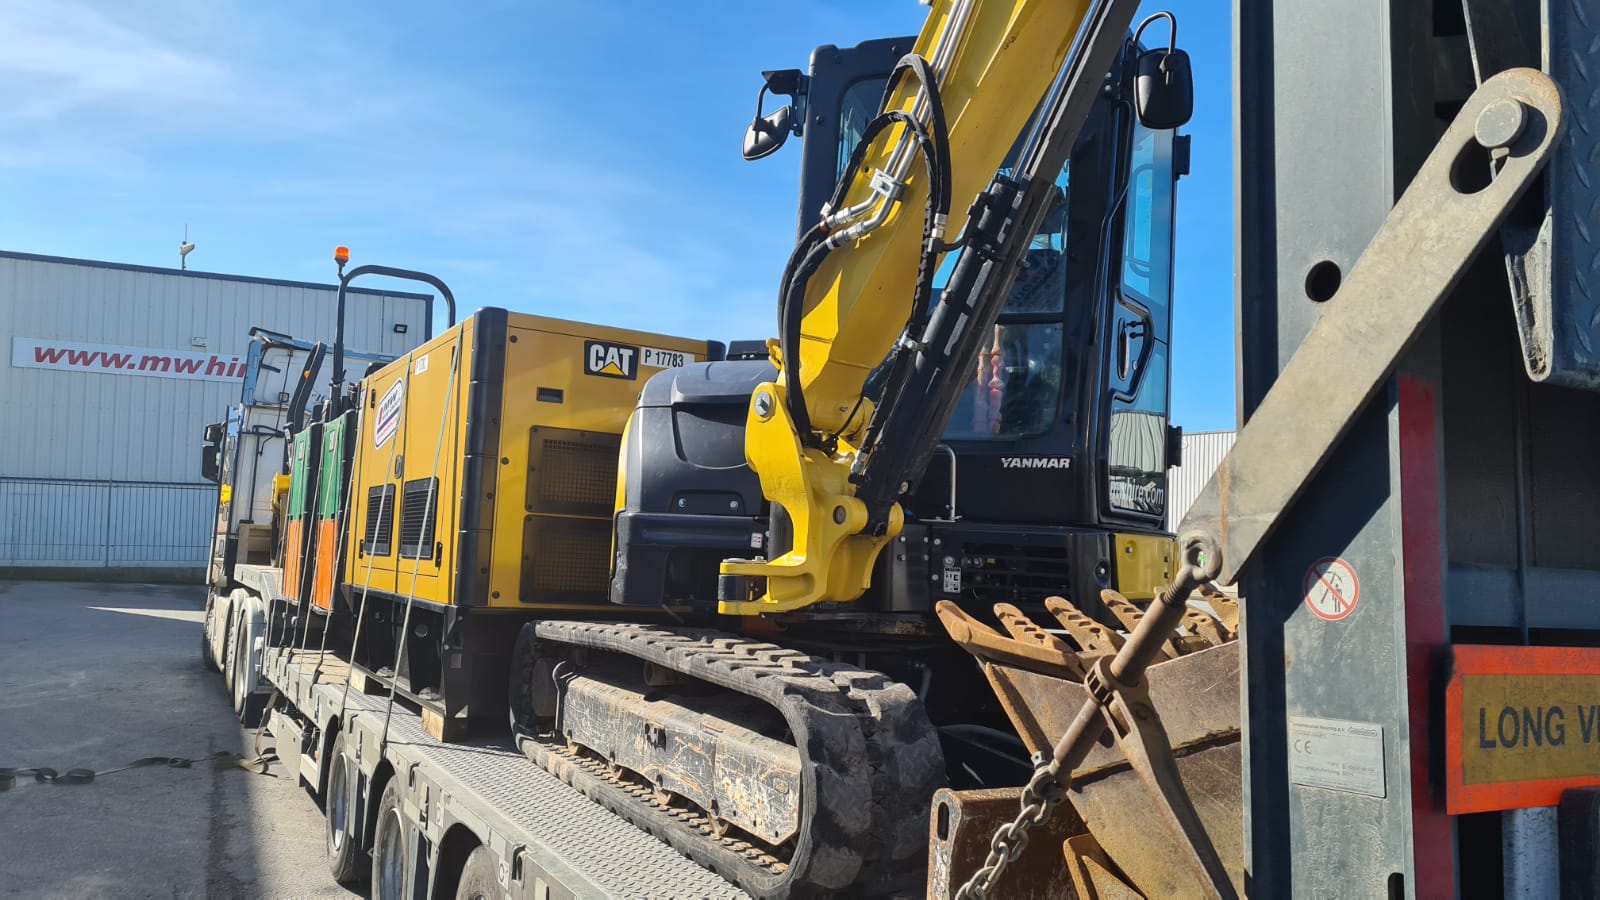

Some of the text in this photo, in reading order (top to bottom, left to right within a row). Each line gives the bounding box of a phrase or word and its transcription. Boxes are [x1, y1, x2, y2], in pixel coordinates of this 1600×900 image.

[589, 343, 633, 376] CAT
[644, 349, 684, 368] P 17783
[1001, 457, 1071, 469] YANMAR
[1479, 704, 1600, 749] LONG V
